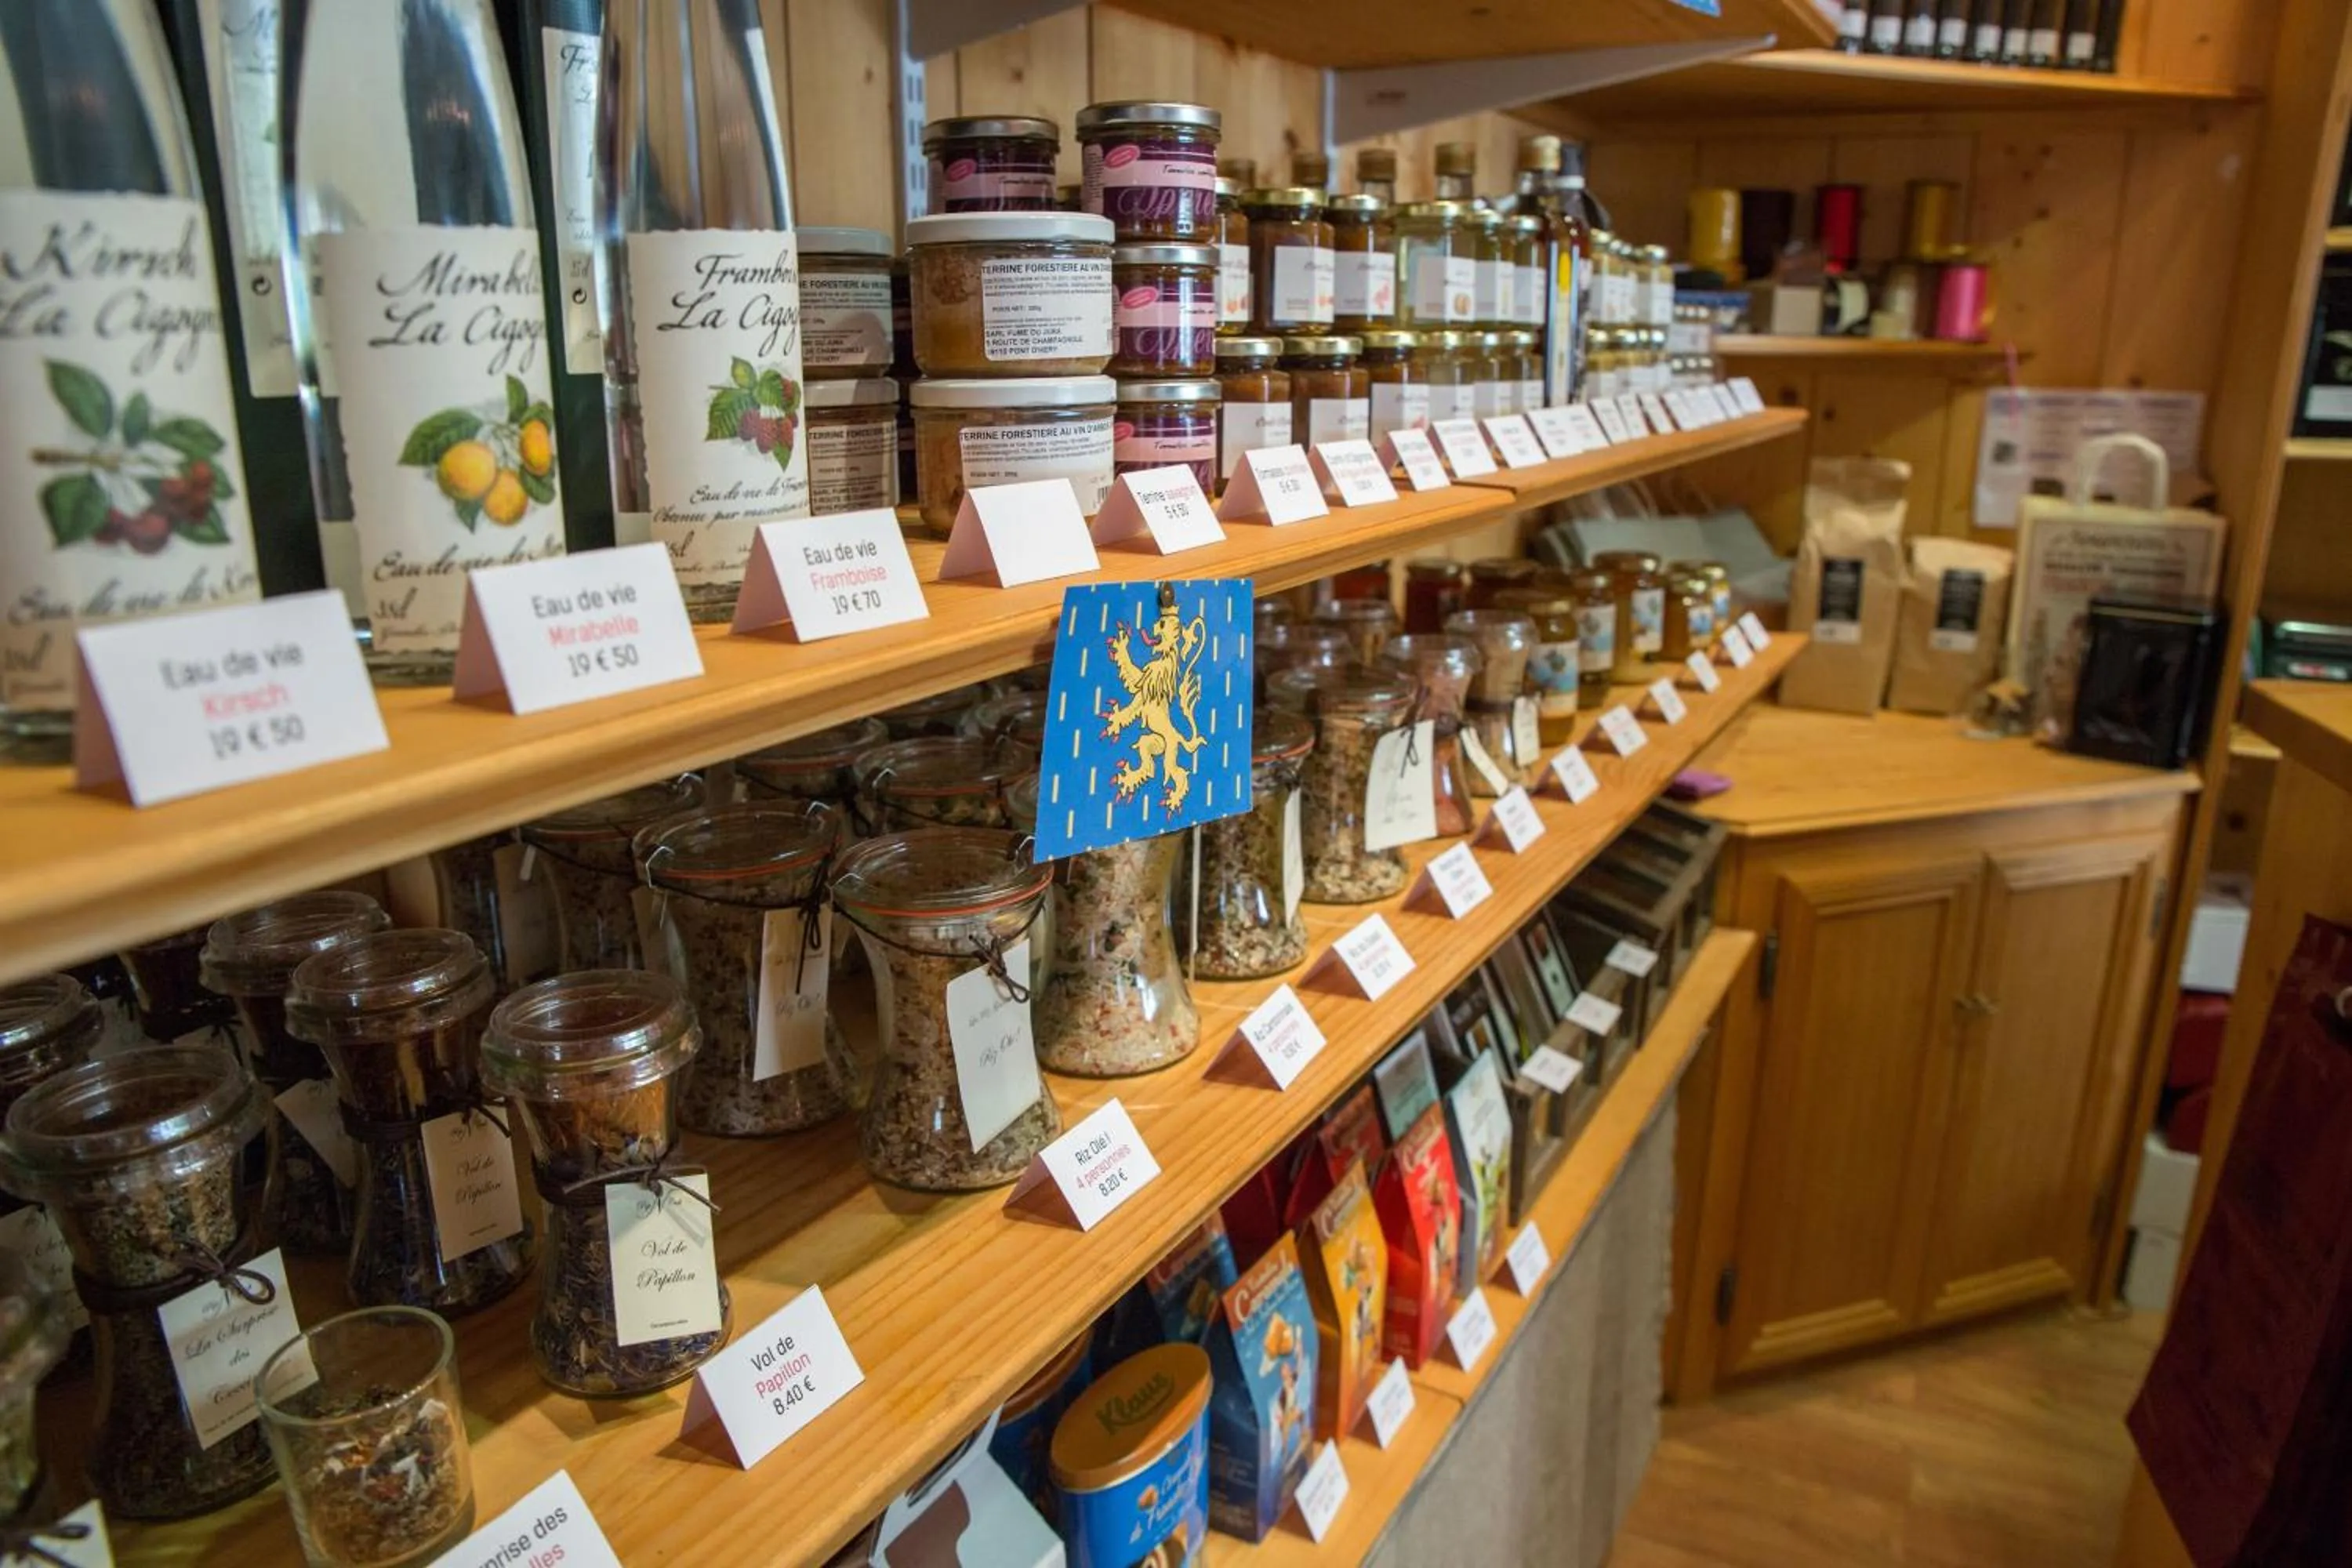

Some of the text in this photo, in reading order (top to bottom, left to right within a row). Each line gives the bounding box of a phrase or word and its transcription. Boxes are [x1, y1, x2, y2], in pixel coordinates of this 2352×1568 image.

[367, 302, 447, 348] La
[656, 289, 729, 332] La
[1001, 429, 1058, 441] FORESTIERE
[803, 539, 877, 566] Eau de vie
[809, 564, 888, 593] Framboise
[531, 583, 637, 620] Eau de vie
[832, 590, 882, 615] 19 € 70
[548, 614, 641, 649] Mirabelle
[159, 641, 305, 690] Eau de vie
[568, 643, 640, 679] 19 € 50
[207, 712, 307, 761] 19 € 50
[1075, 1149, 1092, 1166] Riz
[1084, 1143, 1132, 1188] personnes
[1118, 1167, 1128, 1181] €
[641, 1240, 689, 1258] Vol de
[636, 1267, 696, 1293] Papillon
[750, 1337, 796, 1372] Vol de
[755, 1353, 812, 1400] Papillon
[772, 1374, 817, 1416] 8.40 €
[478, 1507, 569, 1568] prise des
